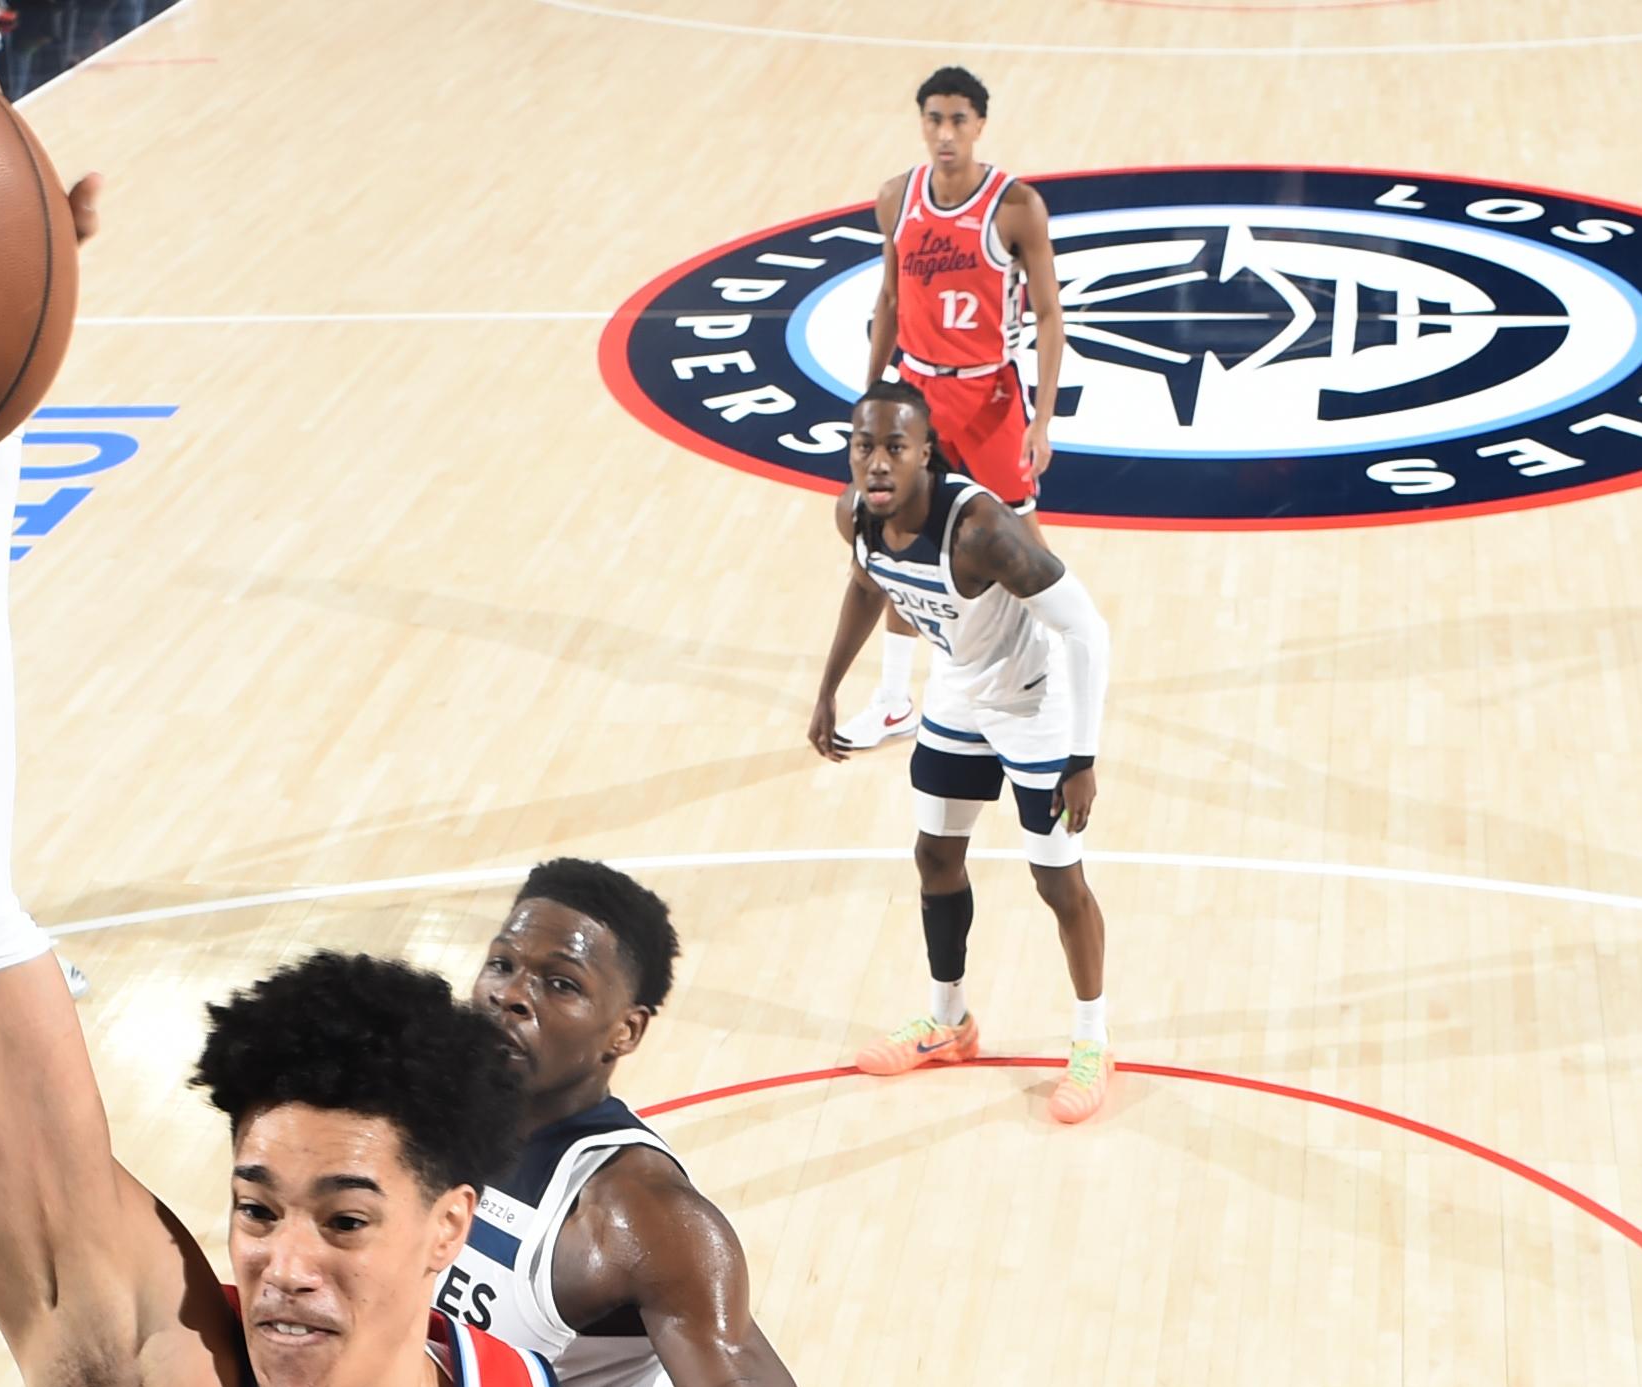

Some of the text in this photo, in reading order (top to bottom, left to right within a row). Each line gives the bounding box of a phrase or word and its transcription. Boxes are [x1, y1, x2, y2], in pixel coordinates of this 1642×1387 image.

[1374, 184, 1635, 244] LOS
[917, 228, 954, 256] Los
[902, 247, 979, 286] Angeles
[938, 289, 980, 330] 12
[671, 226, 886, 454] LIPPERS
[886, 588, 959, 620] OLVES
[479, 1198, 515, 1224] ezzle
